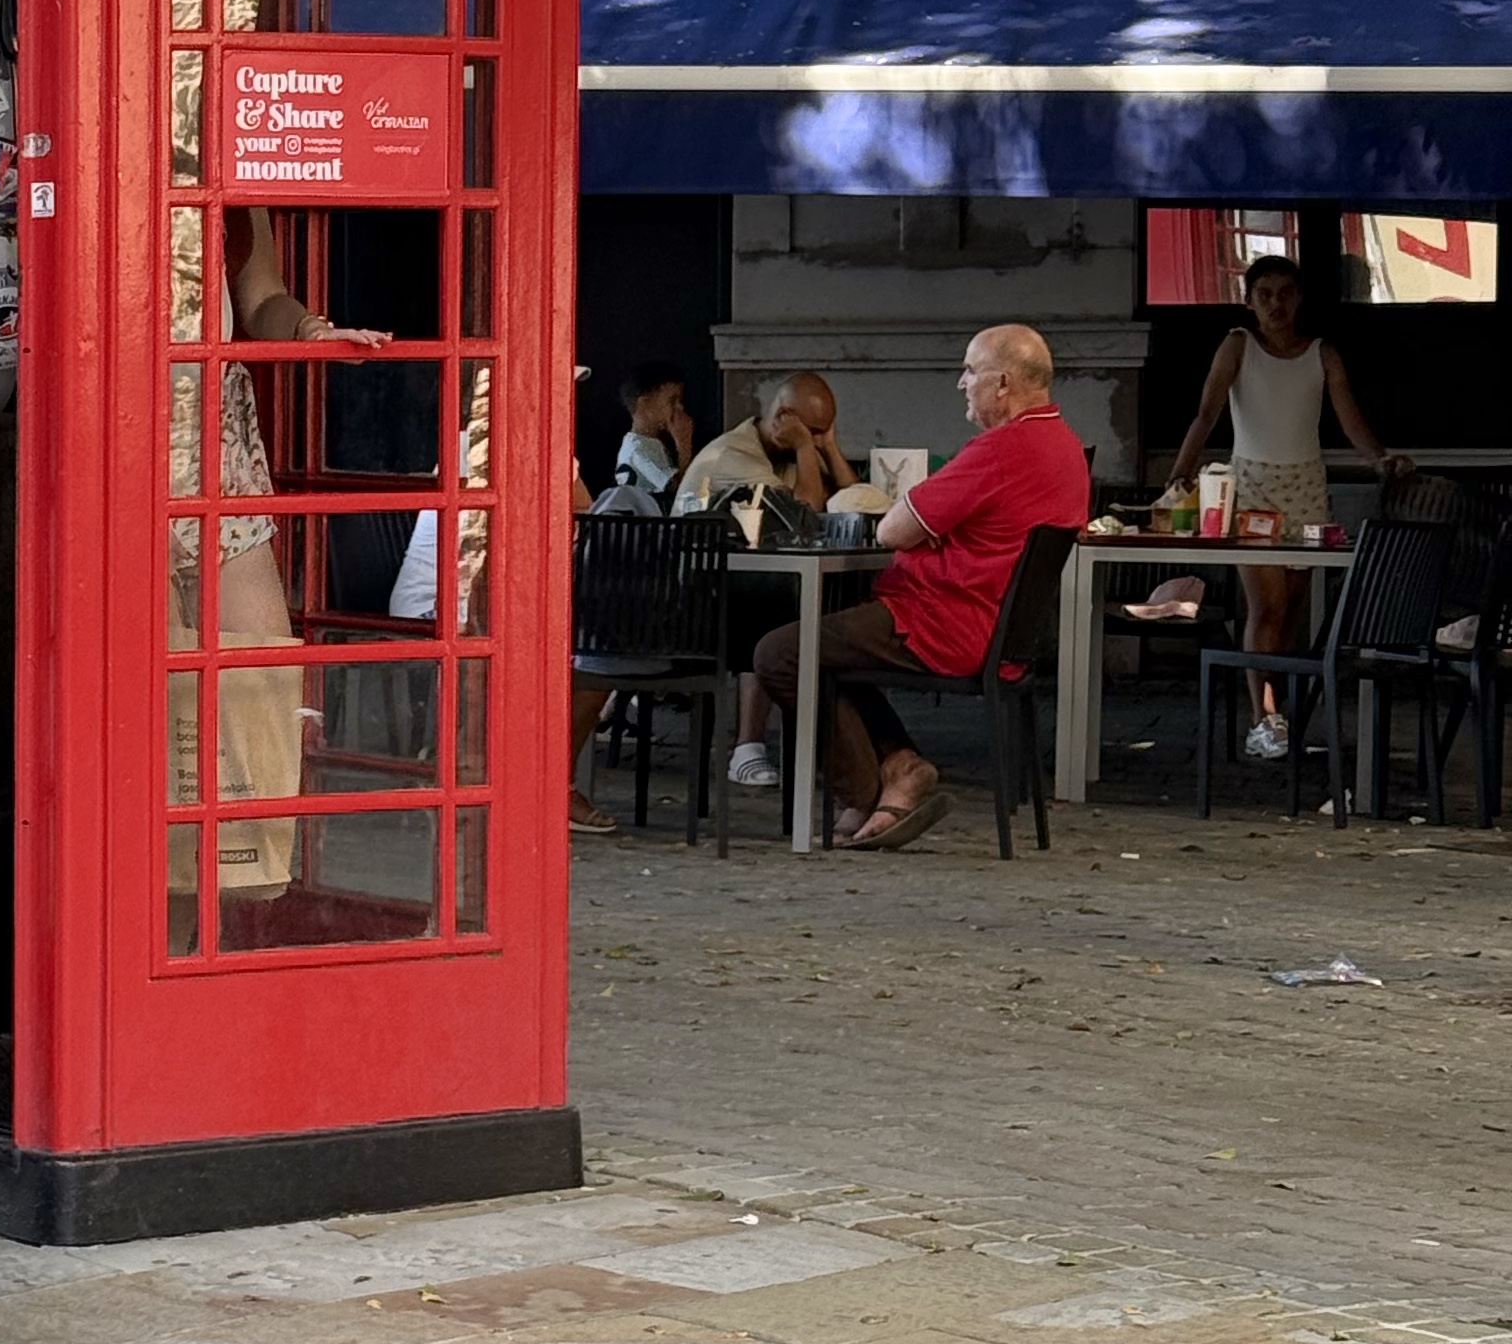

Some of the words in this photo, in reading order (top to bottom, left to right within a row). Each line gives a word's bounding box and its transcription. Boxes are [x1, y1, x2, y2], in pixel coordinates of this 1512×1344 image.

[236, 66, 343, 100] Capture
[236, 98, 265, 130] &
[267, 102, 343, 132] Share
[234, 136, 282, 157] your
[234, 158, 343, 180] moment
